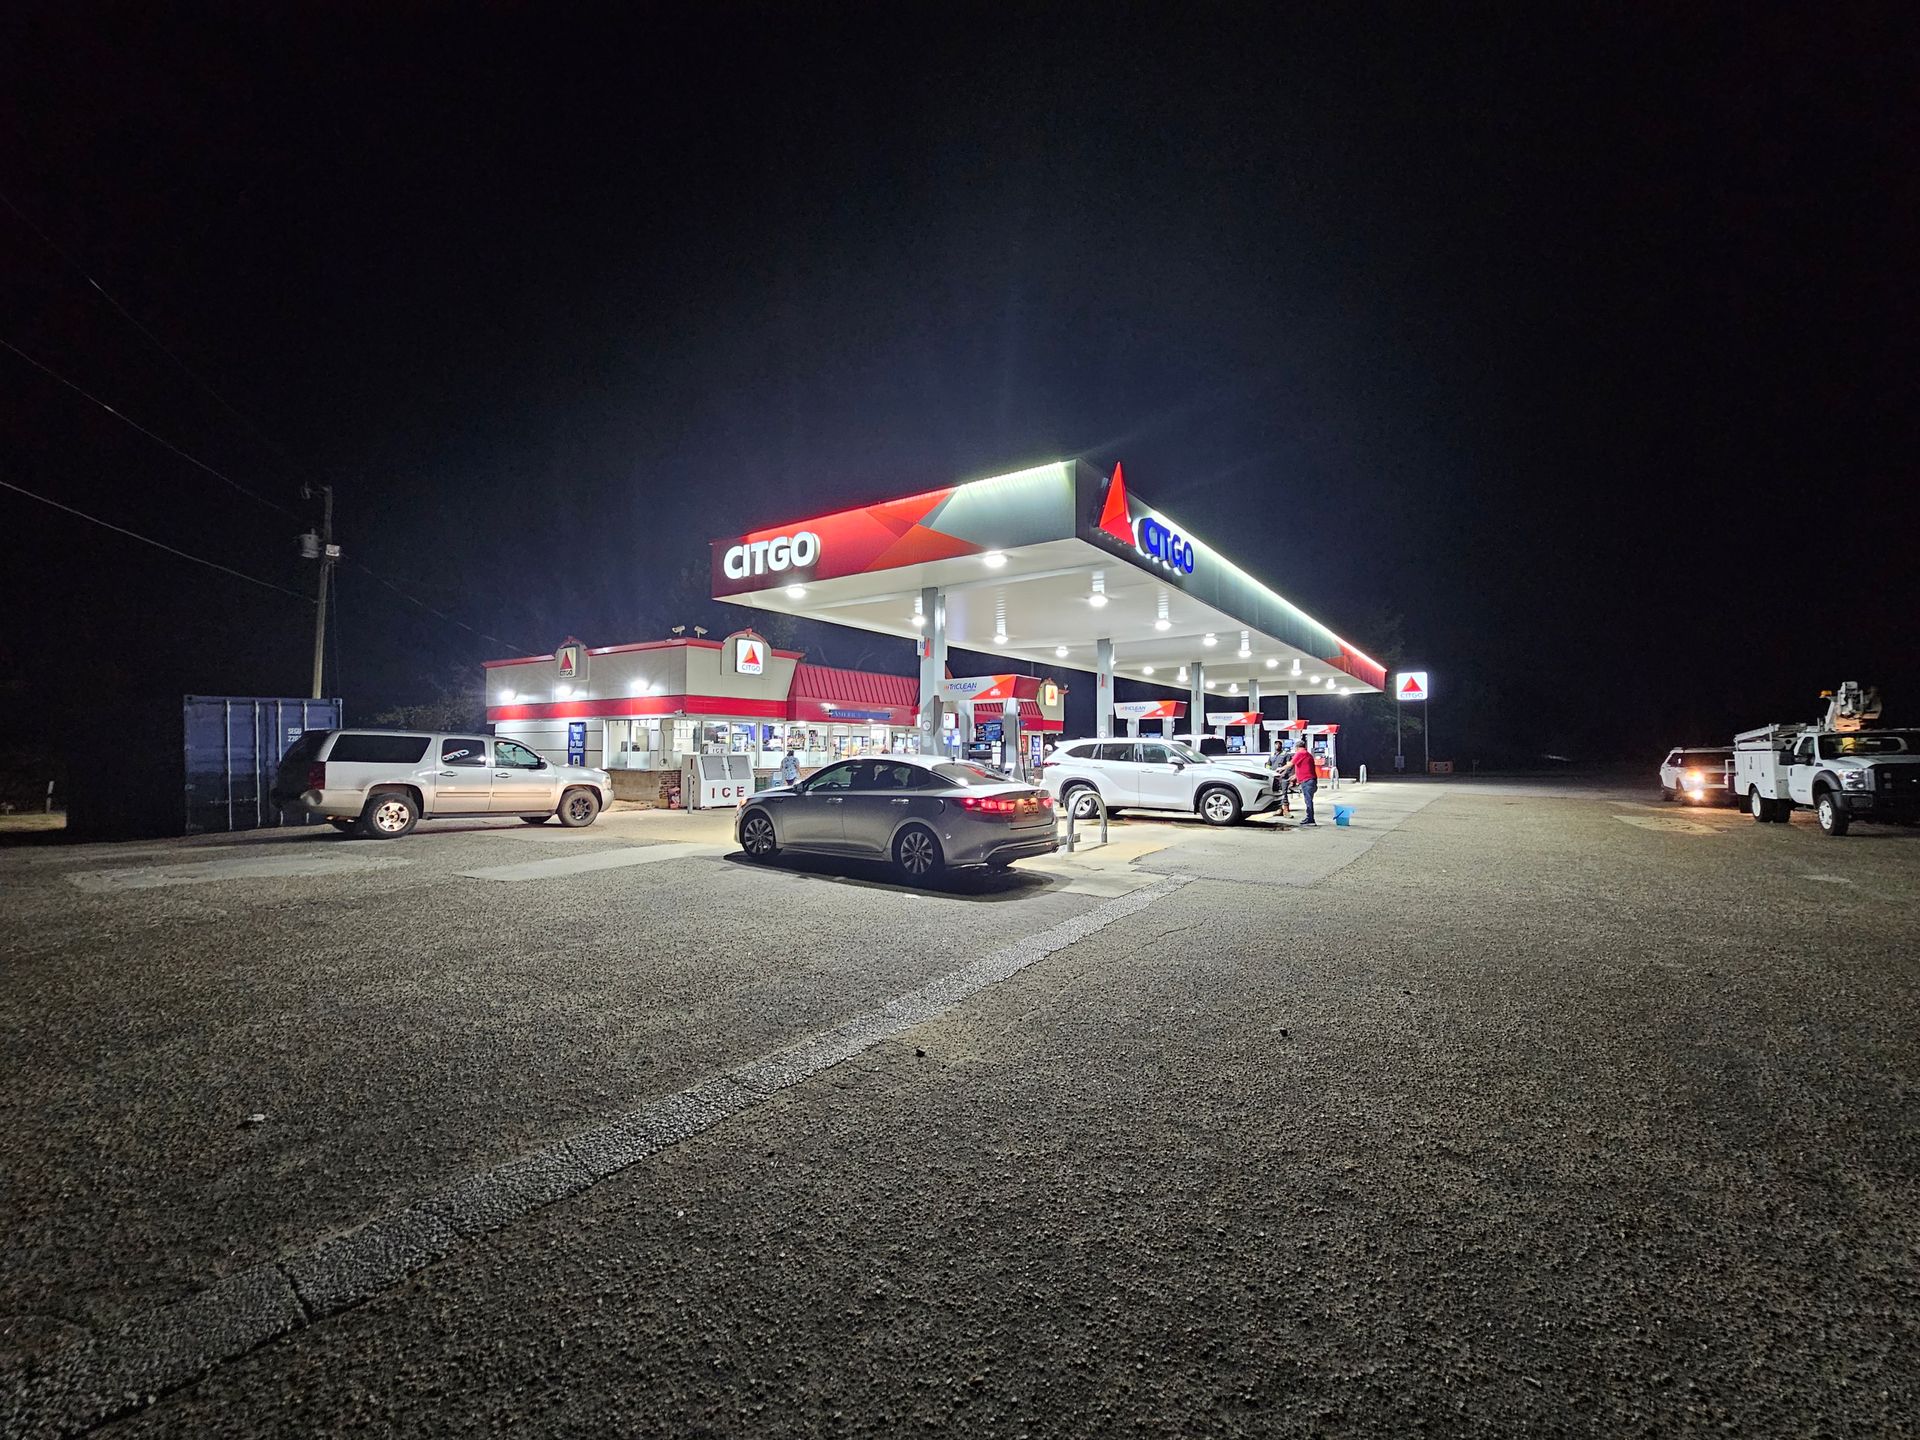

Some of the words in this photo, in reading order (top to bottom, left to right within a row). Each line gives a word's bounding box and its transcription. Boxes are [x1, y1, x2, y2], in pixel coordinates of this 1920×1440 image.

[724, 531, 820, 580] CITGO
[1138, 518, 1194, 574] CITGO
[741, 664, 761, 672] CITGO
[711, 786, 745, 799] ICE
